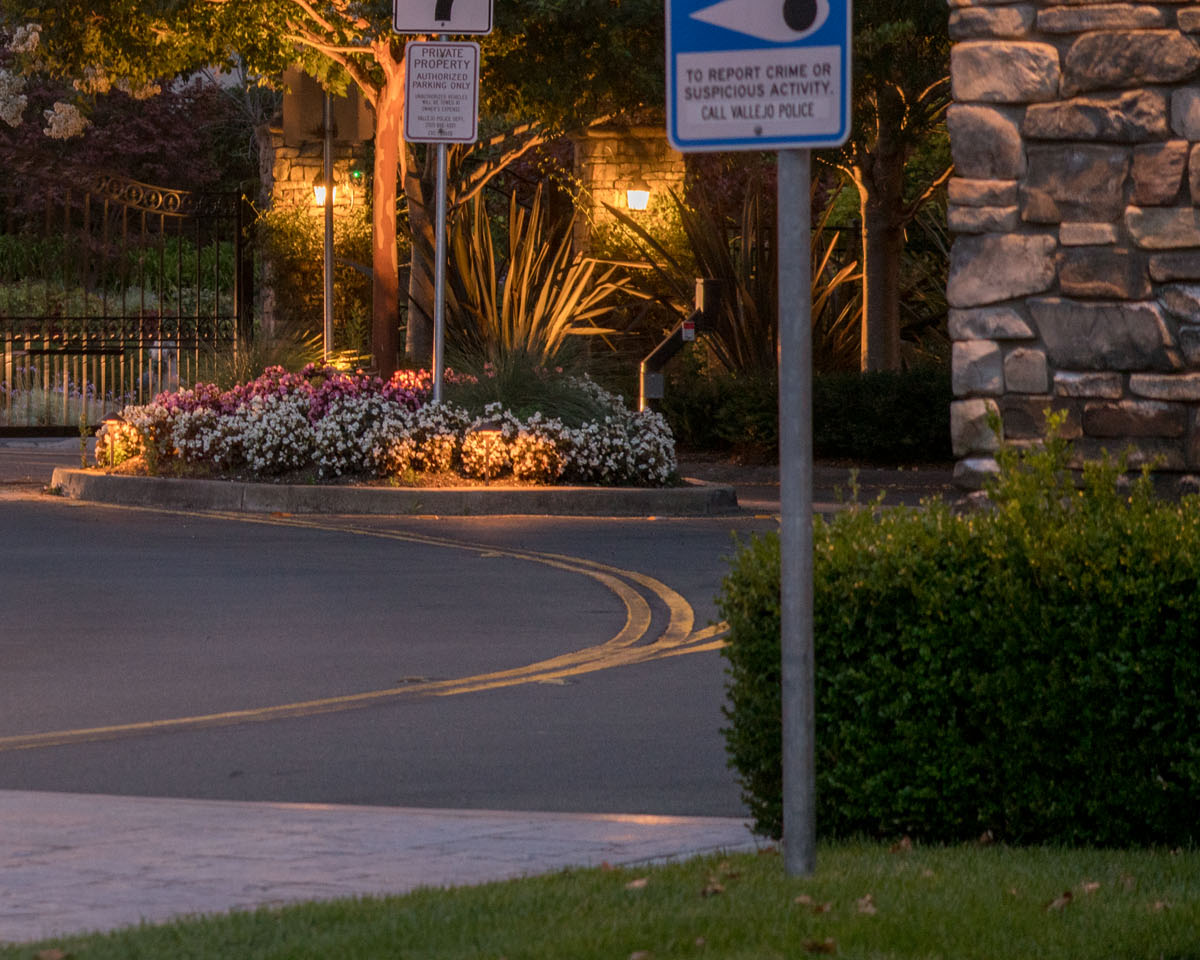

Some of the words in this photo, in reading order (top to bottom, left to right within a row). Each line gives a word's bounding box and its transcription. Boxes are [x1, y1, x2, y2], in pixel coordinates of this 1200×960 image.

[422, 48, 463, 58] PRIVATE
[414, 59, 471, 70] PROPERTY
[417, 72, 468, 81] AUTHORIZED
[686, 68, 703, 83] TO
[708, 66, 761, 81] REPORT
[766, 64, 808, 79] CRIME
[813, 62, 832, 77] OR
[412, 81, 447, 89] PARKING
[451, 81, 471, 90] ONLY
[684, 83, 765, 101] SUSPICIOUS
[770, 81, 834, 98] ACTIVITY.
[701, 104, 726, 121] CALL
[731, 103, 775, 120] VALLEJO
[778, 102, 815, 118] POLICE
